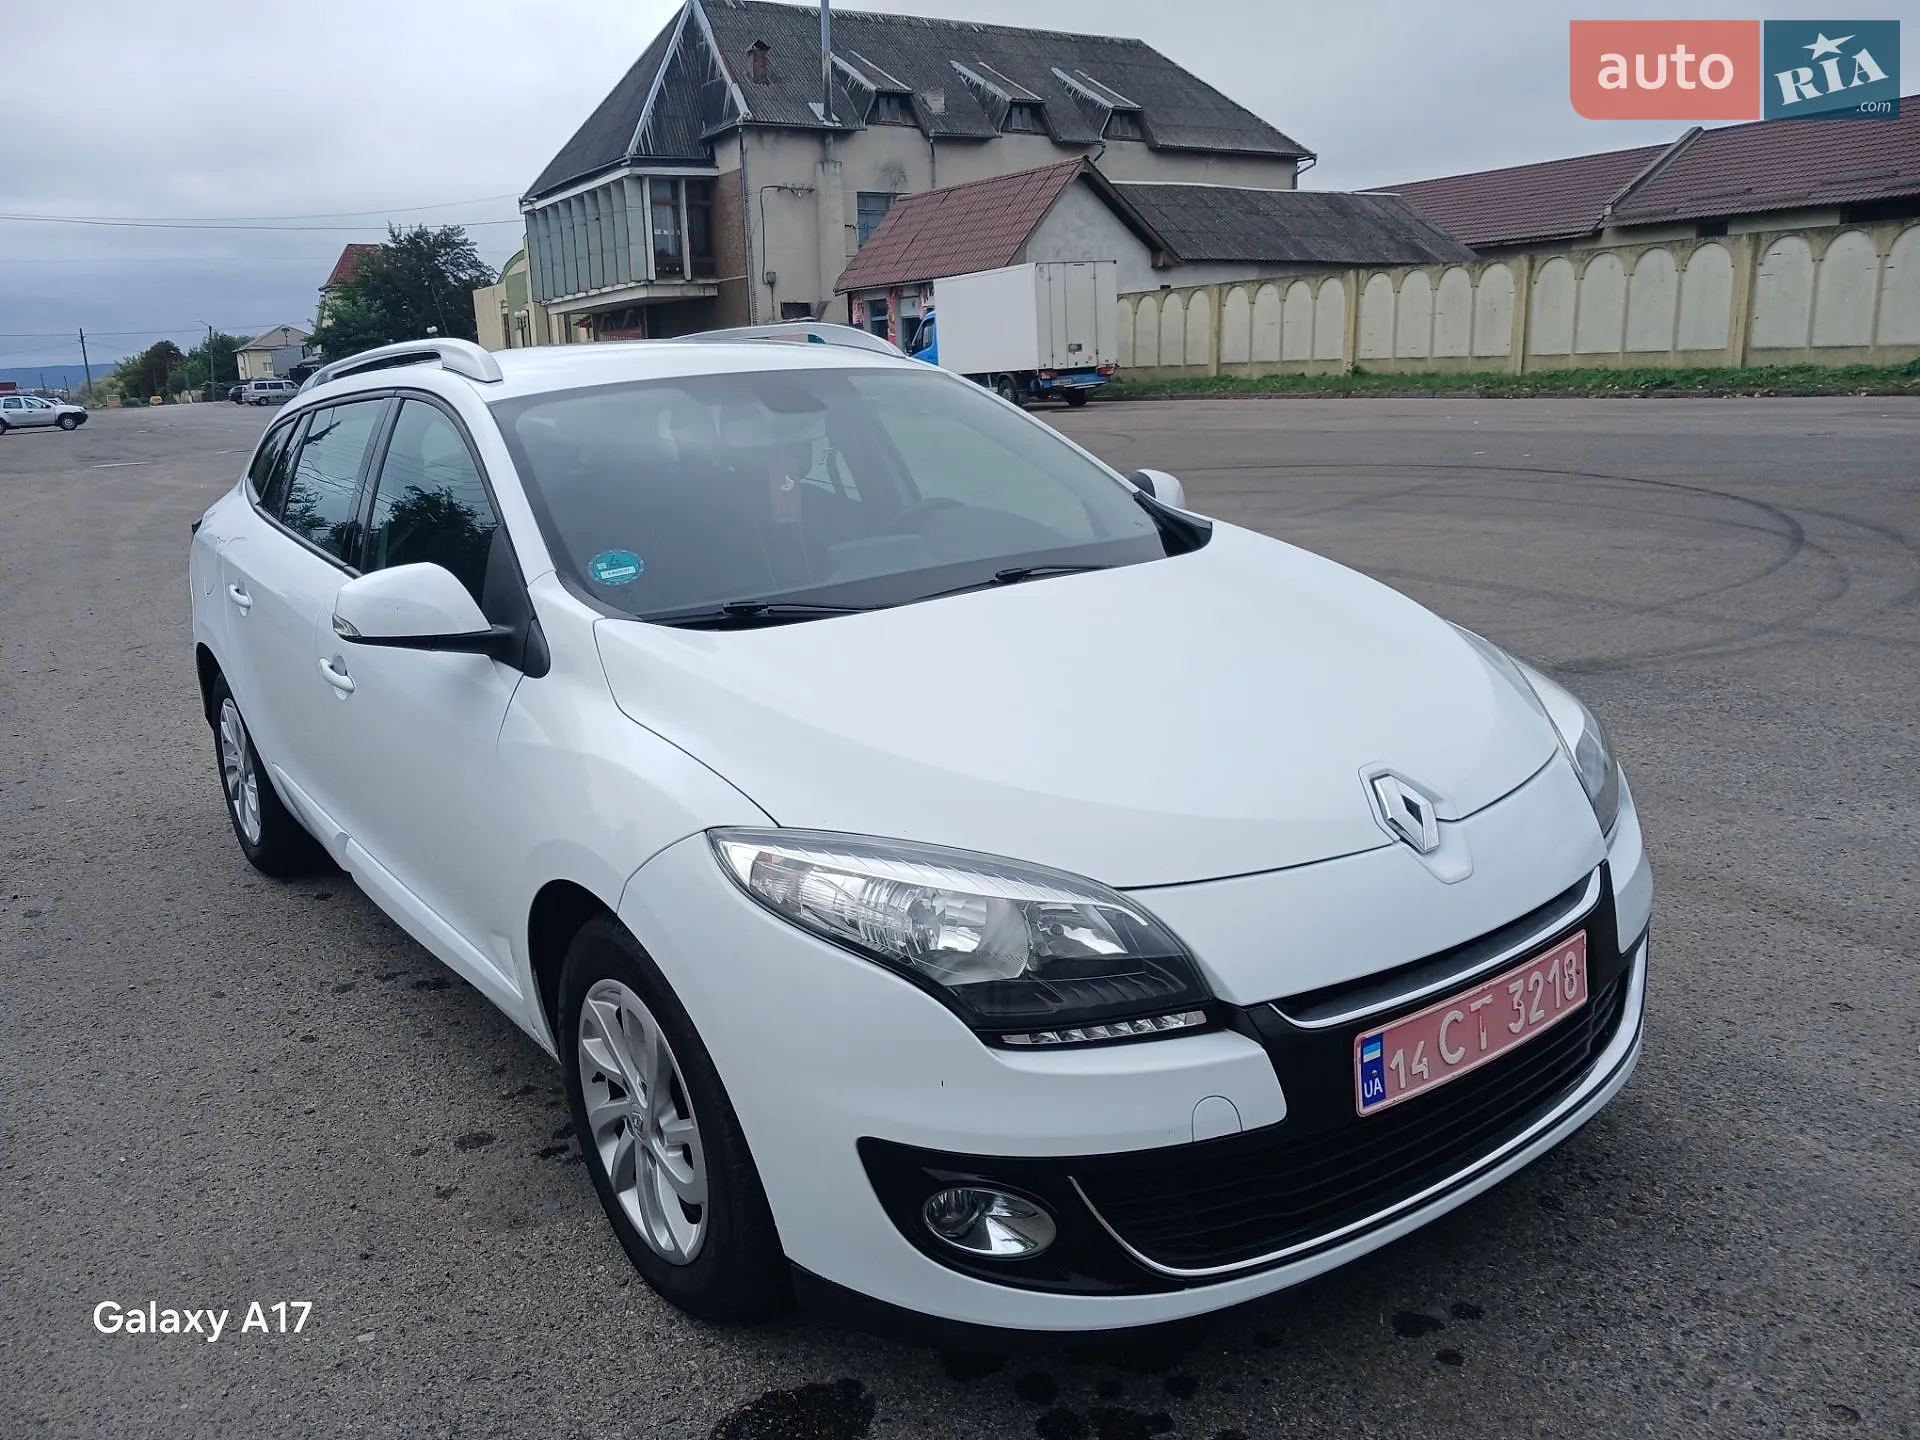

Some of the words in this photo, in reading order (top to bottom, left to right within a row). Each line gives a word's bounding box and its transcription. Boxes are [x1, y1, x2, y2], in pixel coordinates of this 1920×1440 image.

[1389, 1040, 1430, 1090] 14
[1507, 951, 1579, 1034] 3218
[1363, 1077, 1384, 1098] UA
